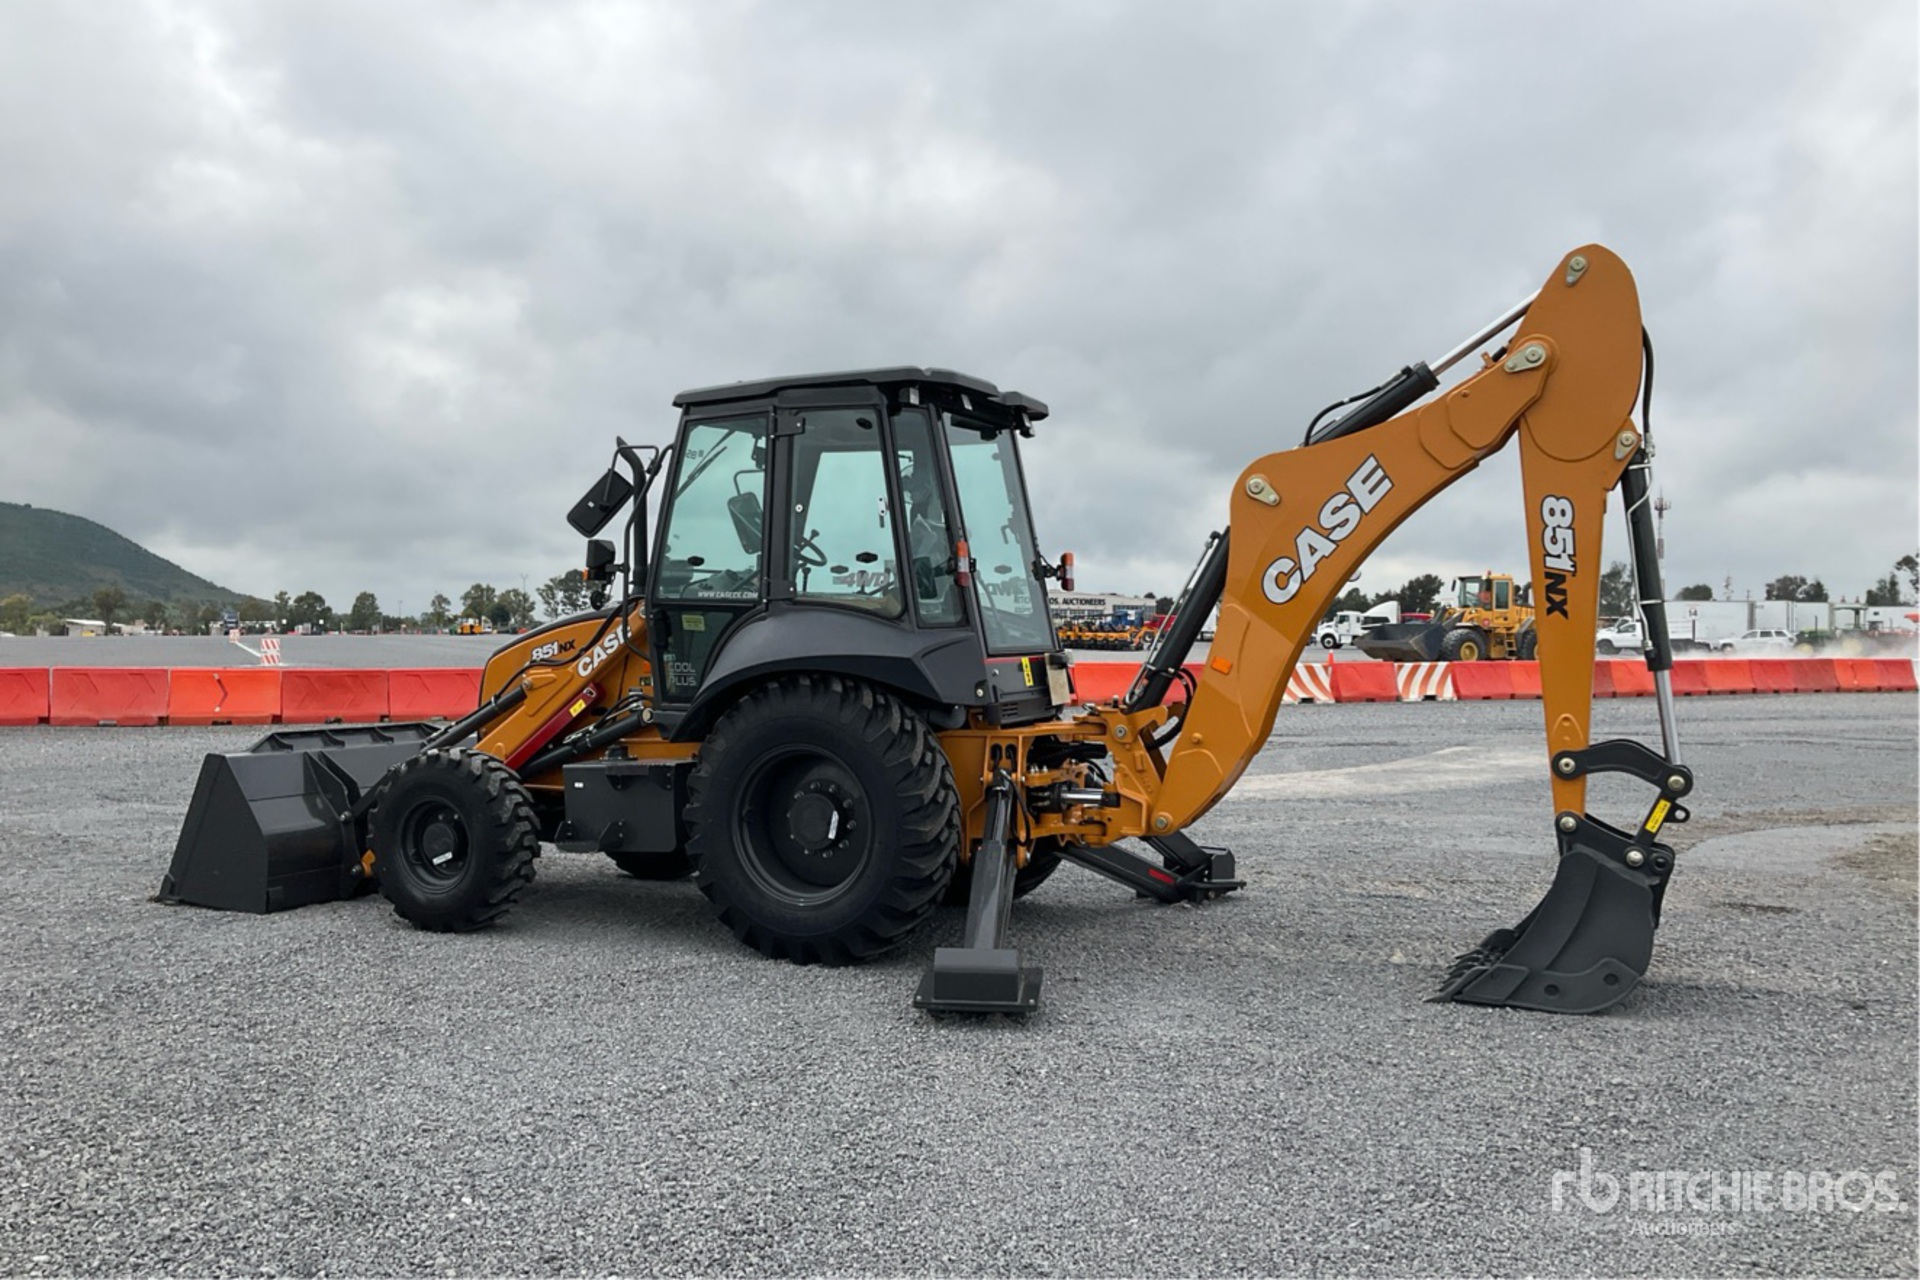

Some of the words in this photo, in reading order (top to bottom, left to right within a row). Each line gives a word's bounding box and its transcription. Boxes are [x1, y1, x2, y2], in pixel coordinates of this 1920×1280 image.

[1261, 453, 1395, 604] CASE
[1062, 598, 1106, 606] AUCTIONEERS
[669, 676, 697, 686] PLUS
